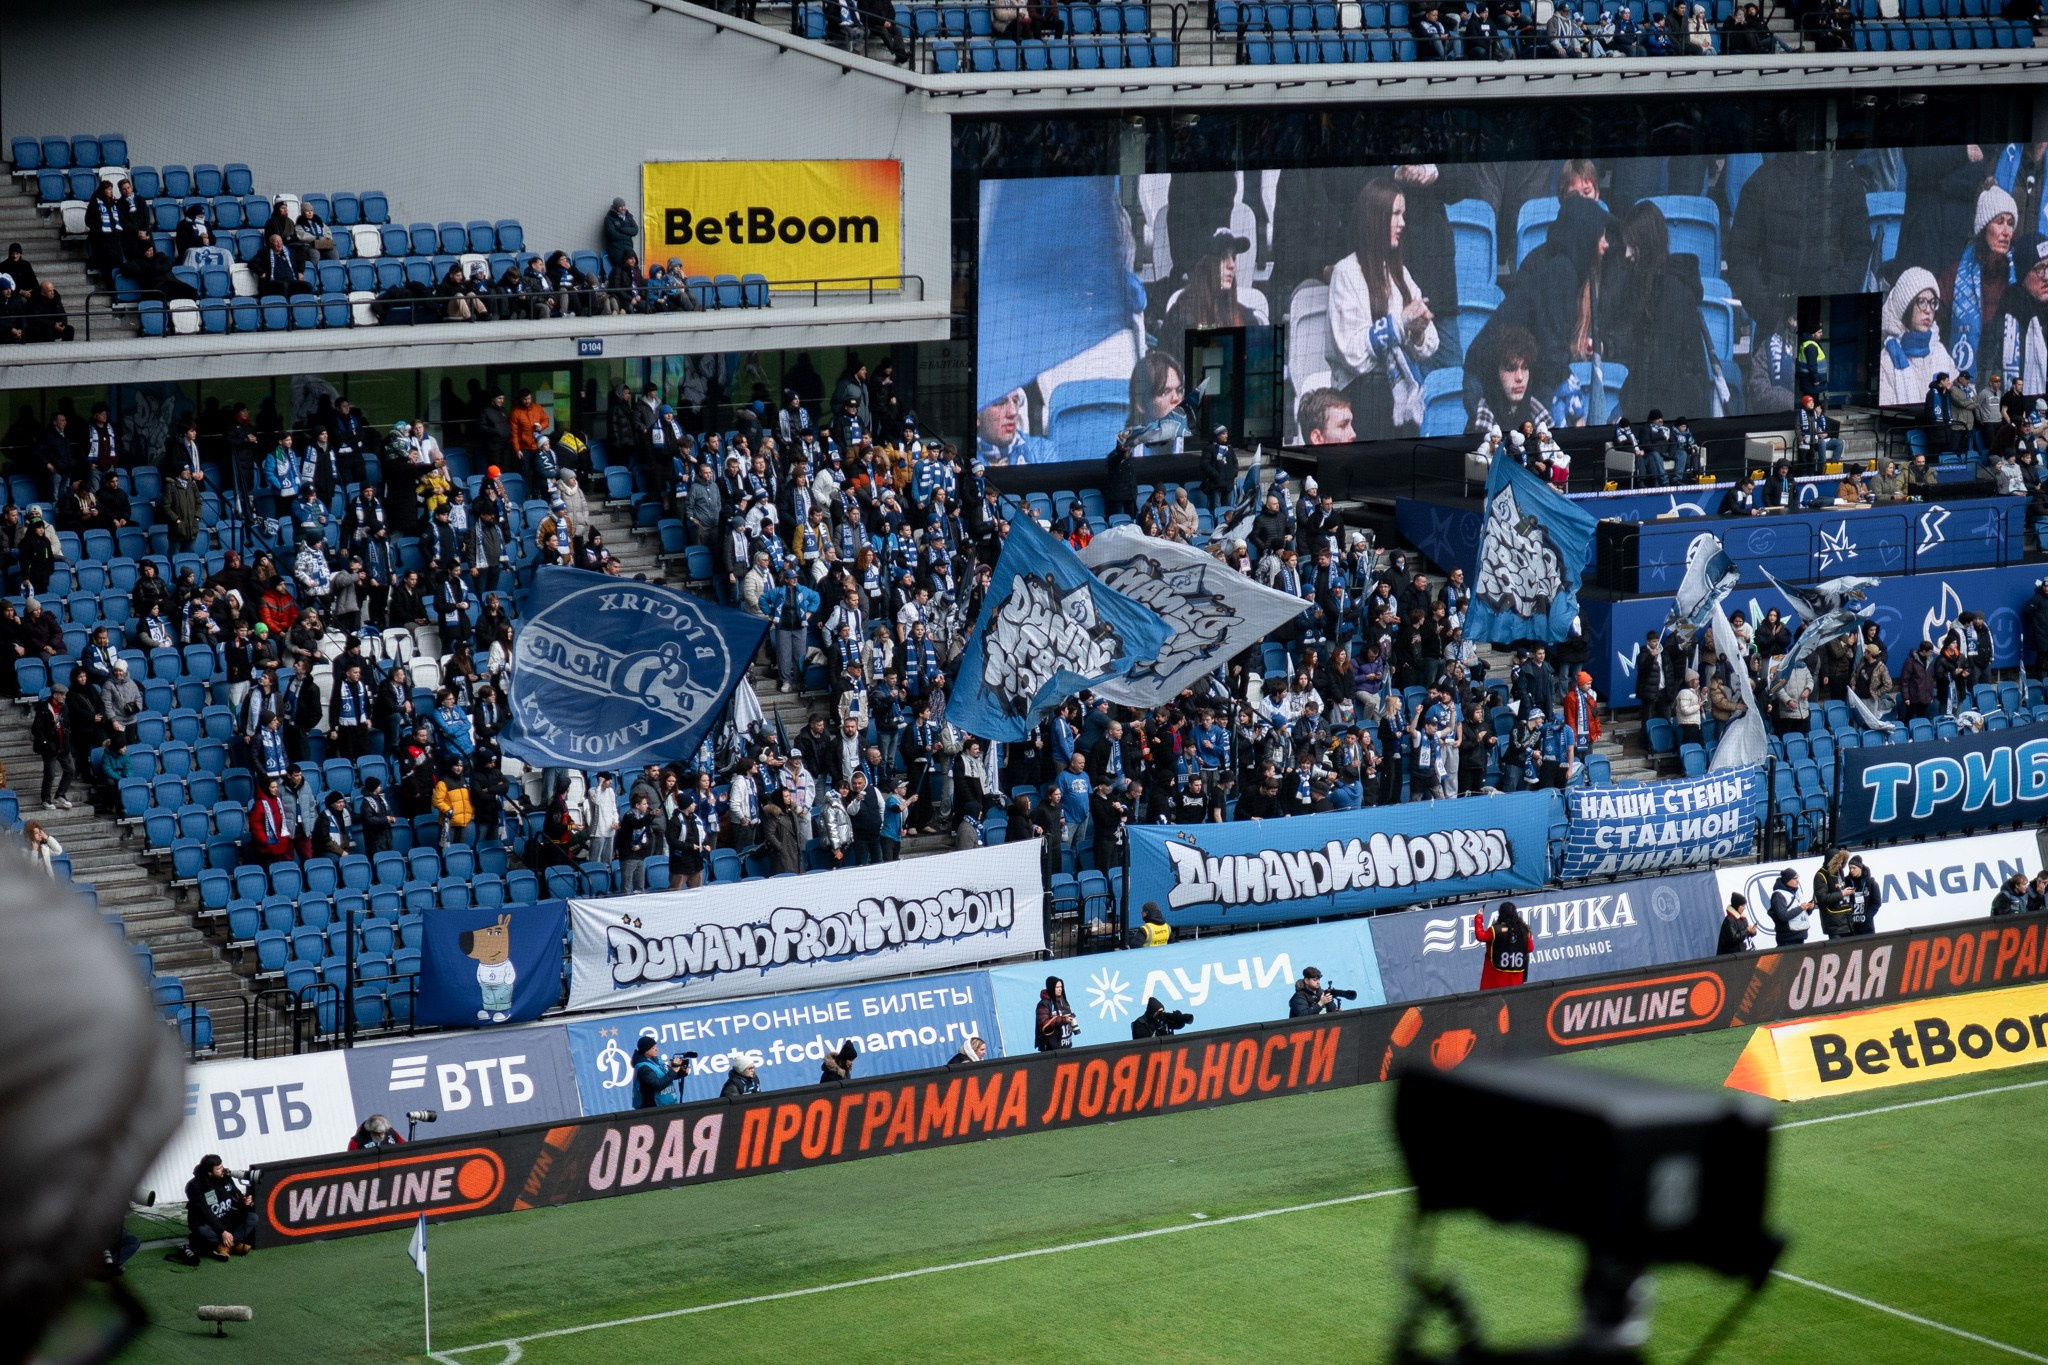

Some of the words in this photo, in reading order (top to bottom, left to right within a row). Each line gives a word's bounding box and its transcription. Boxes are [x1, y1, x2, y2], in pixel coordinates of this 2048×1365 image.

[664, 206, 879, 245] BetBoom
[588, 342, 601, 351] 104
[1580, 792, 1657, 820] НАШИ
[1594, 808, 1740, 850] СТАДИОН
[1881, 857, 2026, 904] ANGAN
[1500, 952, 1524, 968] 816
[1528, 940, 1613, 965] АЛКОГОЛЬНОЕ
[1788, 945, 1893, 1012] ОВАЯ
[1900, 923, 2048, 995] ПРОГРА
[638, 1001, 852, 1044] ЭЛЕКТРОННЫЕ
[862, 985, 973, 1018] БИЛЕТЫ
[1562, 986, 1690, 1034] WINLINE
[436, 1054, 535, 1112] ВТБ
[209, 1082, 313, 1141] ВТБ
[588, 1113, 724, 1190] ОВАЯ
[735, 1067, 1028, 1171] ПРОГРАММА
[1042, 1025, 1341, 1125] ЛОЯЛЬНОСТИ
[288, 1166, 455, 1222] WINLINE
